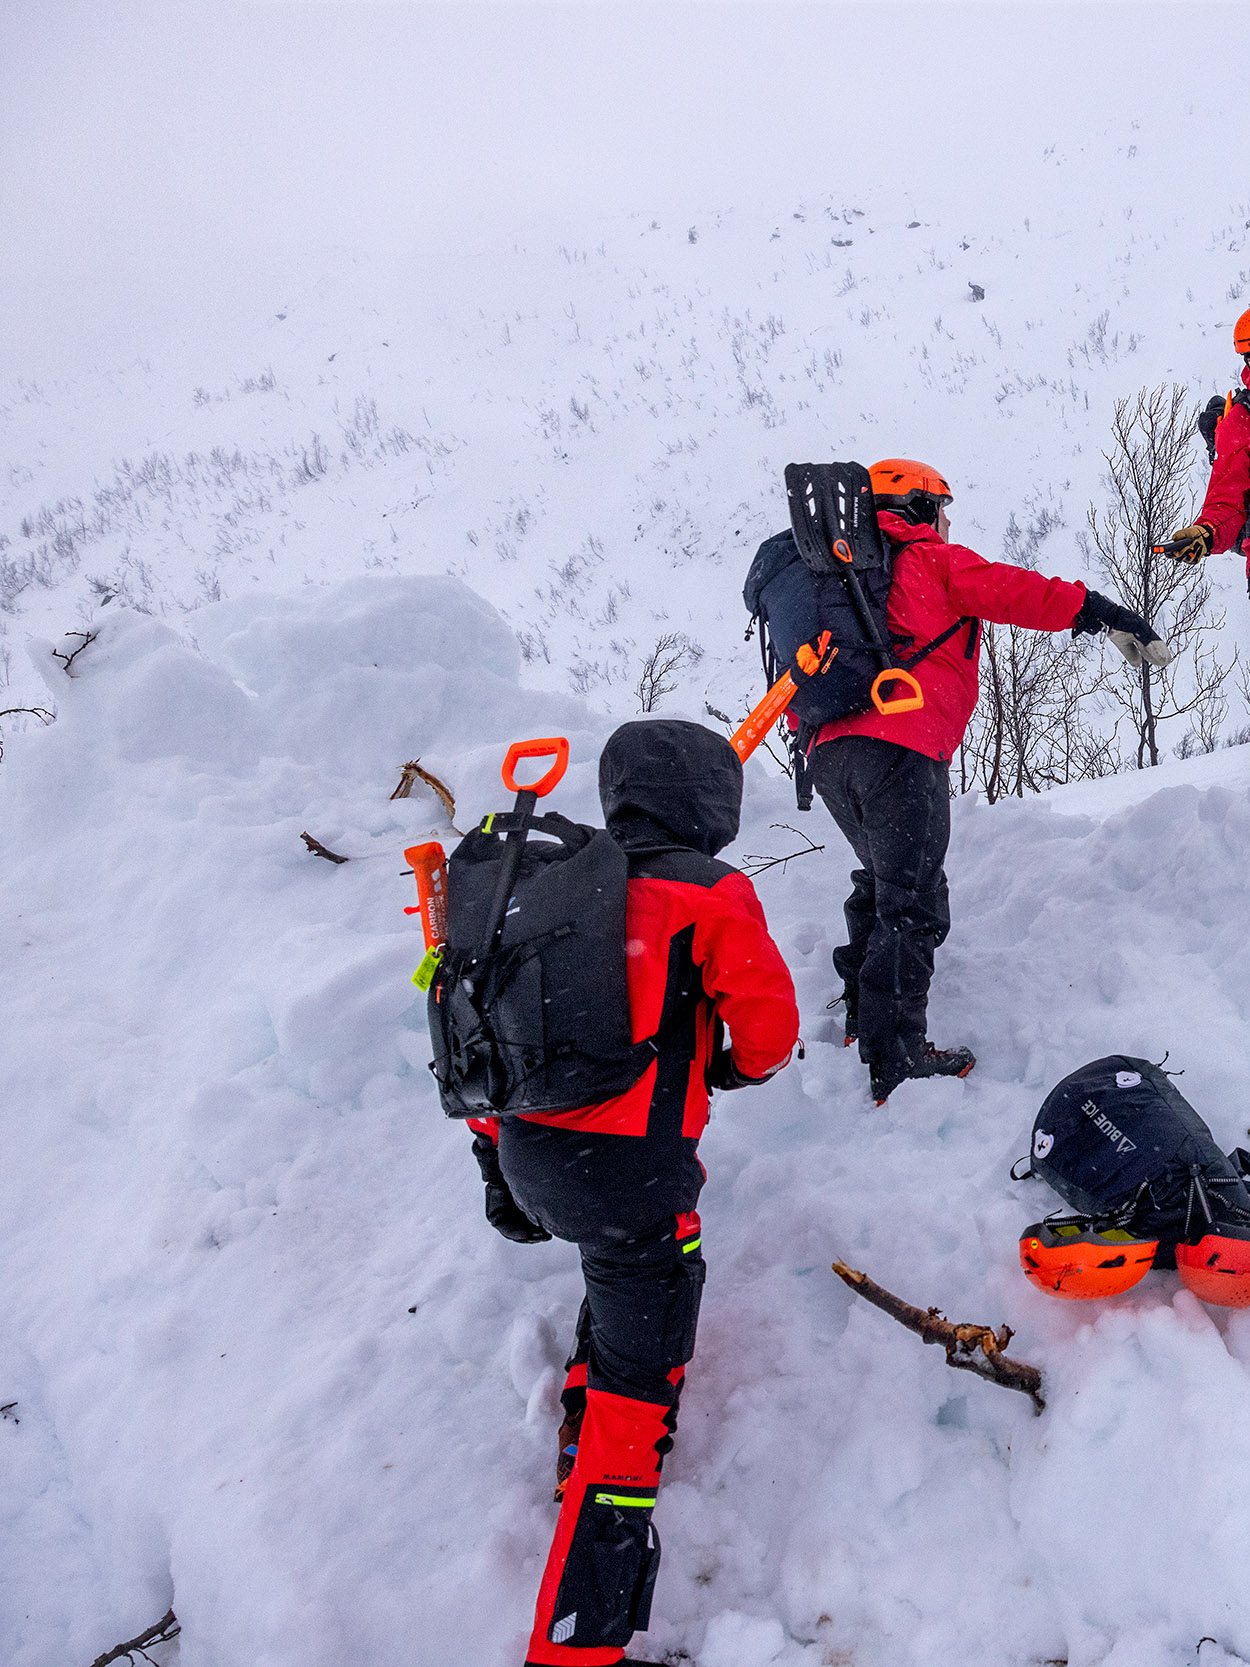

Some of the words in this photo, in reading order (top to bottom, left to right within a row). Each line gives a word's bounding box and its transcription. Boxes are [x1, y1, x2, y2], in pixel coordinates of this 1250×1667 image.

[427, 897, 440, 939] CARBON
[1080, 1099, 1100, 1118] ICE
[1093, 1113, 1123, 1142] BLUE
